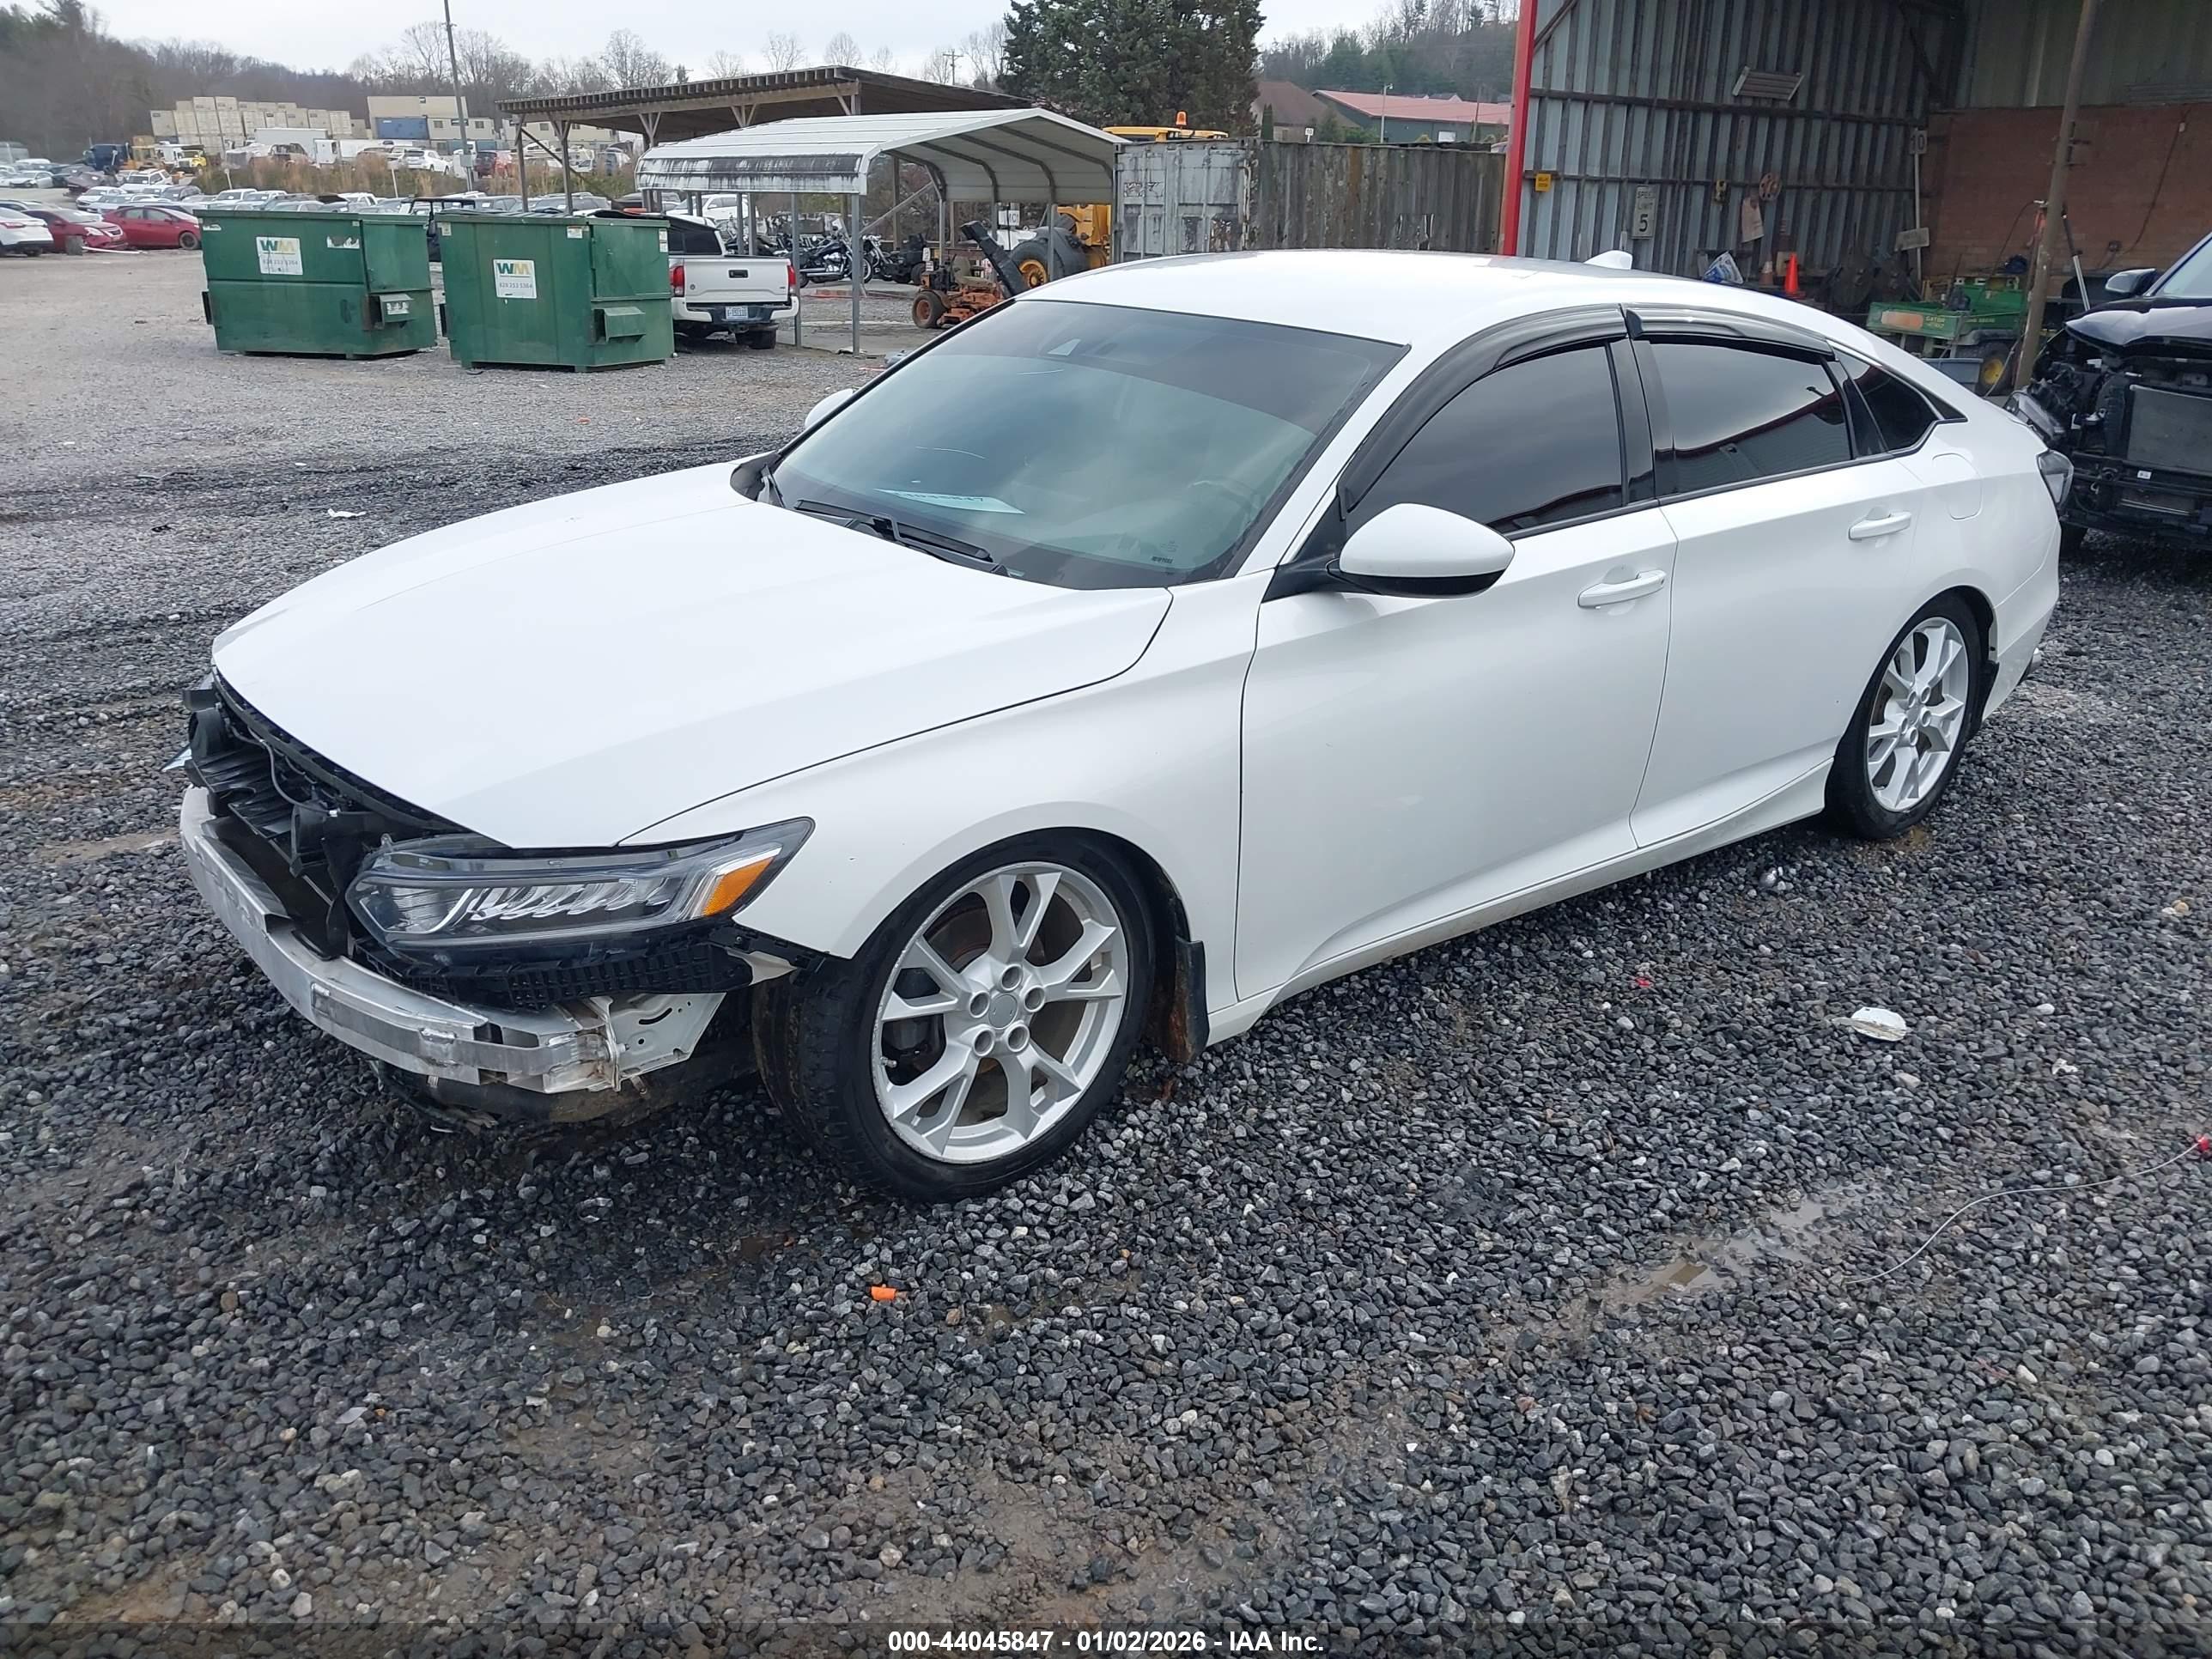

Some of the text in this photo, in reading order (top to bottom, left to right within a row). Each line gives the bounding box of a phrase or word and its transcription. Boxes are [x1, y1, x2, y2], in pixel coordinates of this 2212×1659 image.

[1639, 213, 1649, 232] 5
[259, 240, 296, 252] WM
[497, 263, 530, 274] WM
